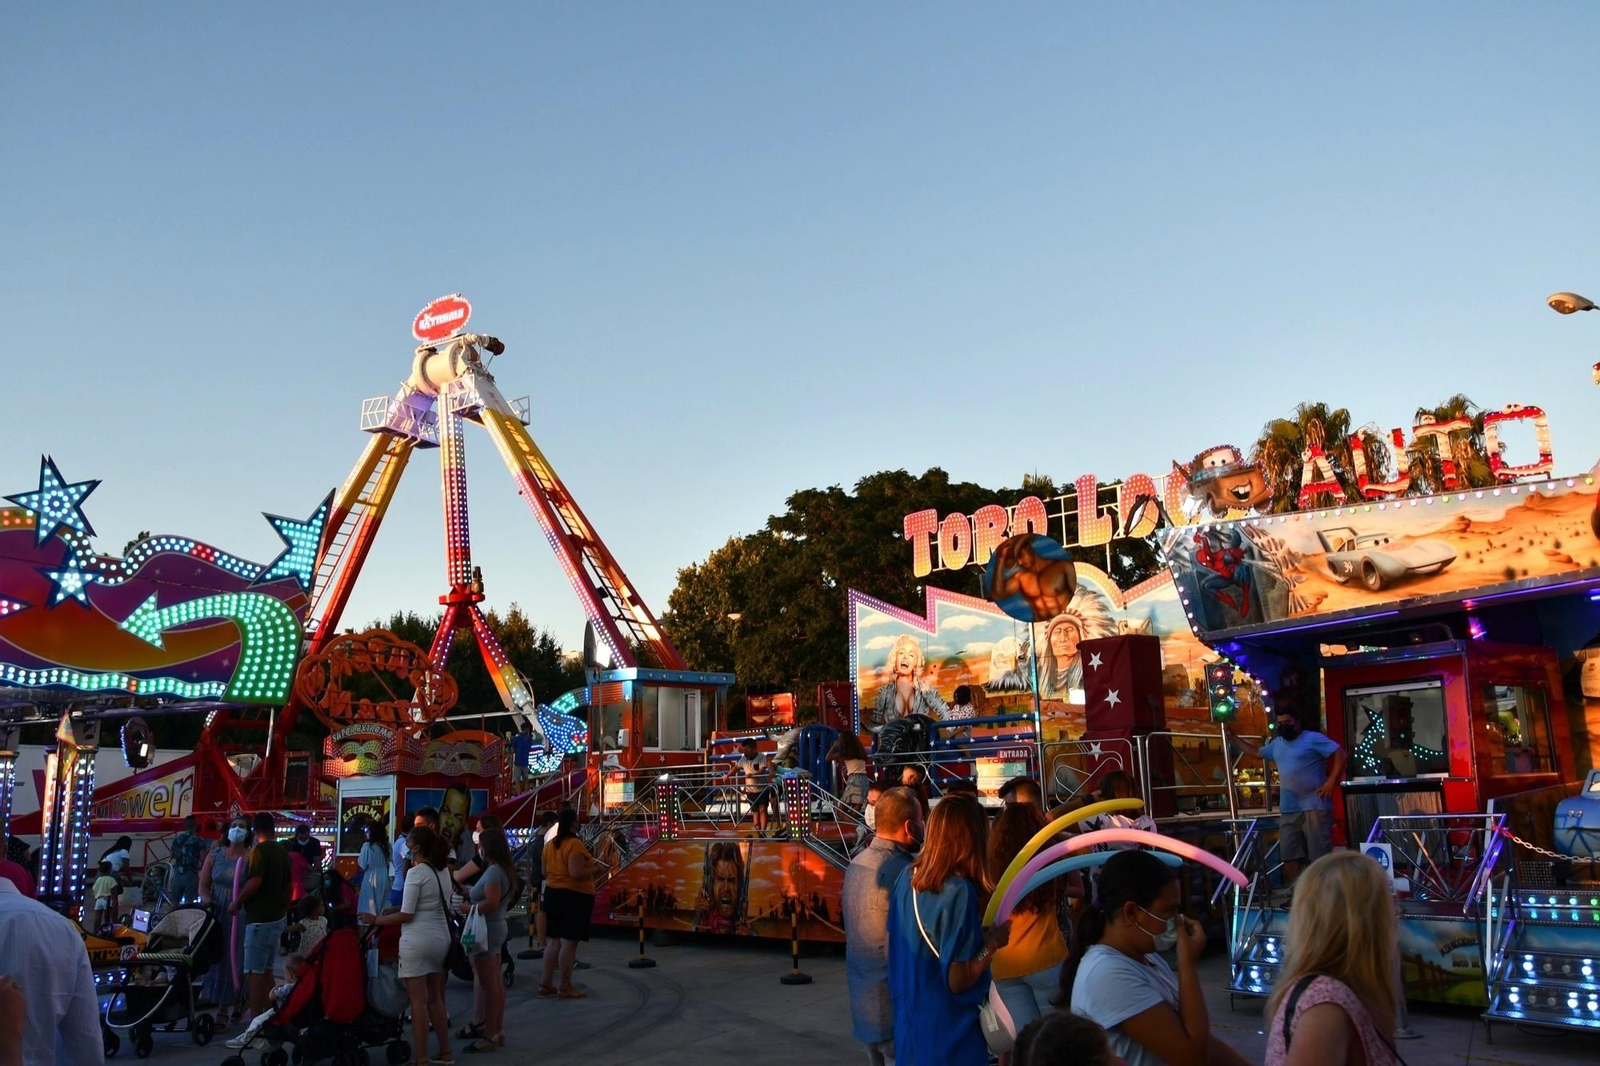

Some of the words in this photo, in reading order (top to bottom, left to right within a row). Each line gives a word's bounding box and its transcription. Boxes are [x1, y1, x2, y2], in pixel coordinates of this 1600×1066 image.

[1299, 402, 1554, 508] AUTO
[904, 496, 1048, 577] TORO
[999, 750, 1028, 758] ENTRADA
[342, 805, 382, 823] EXTREME
